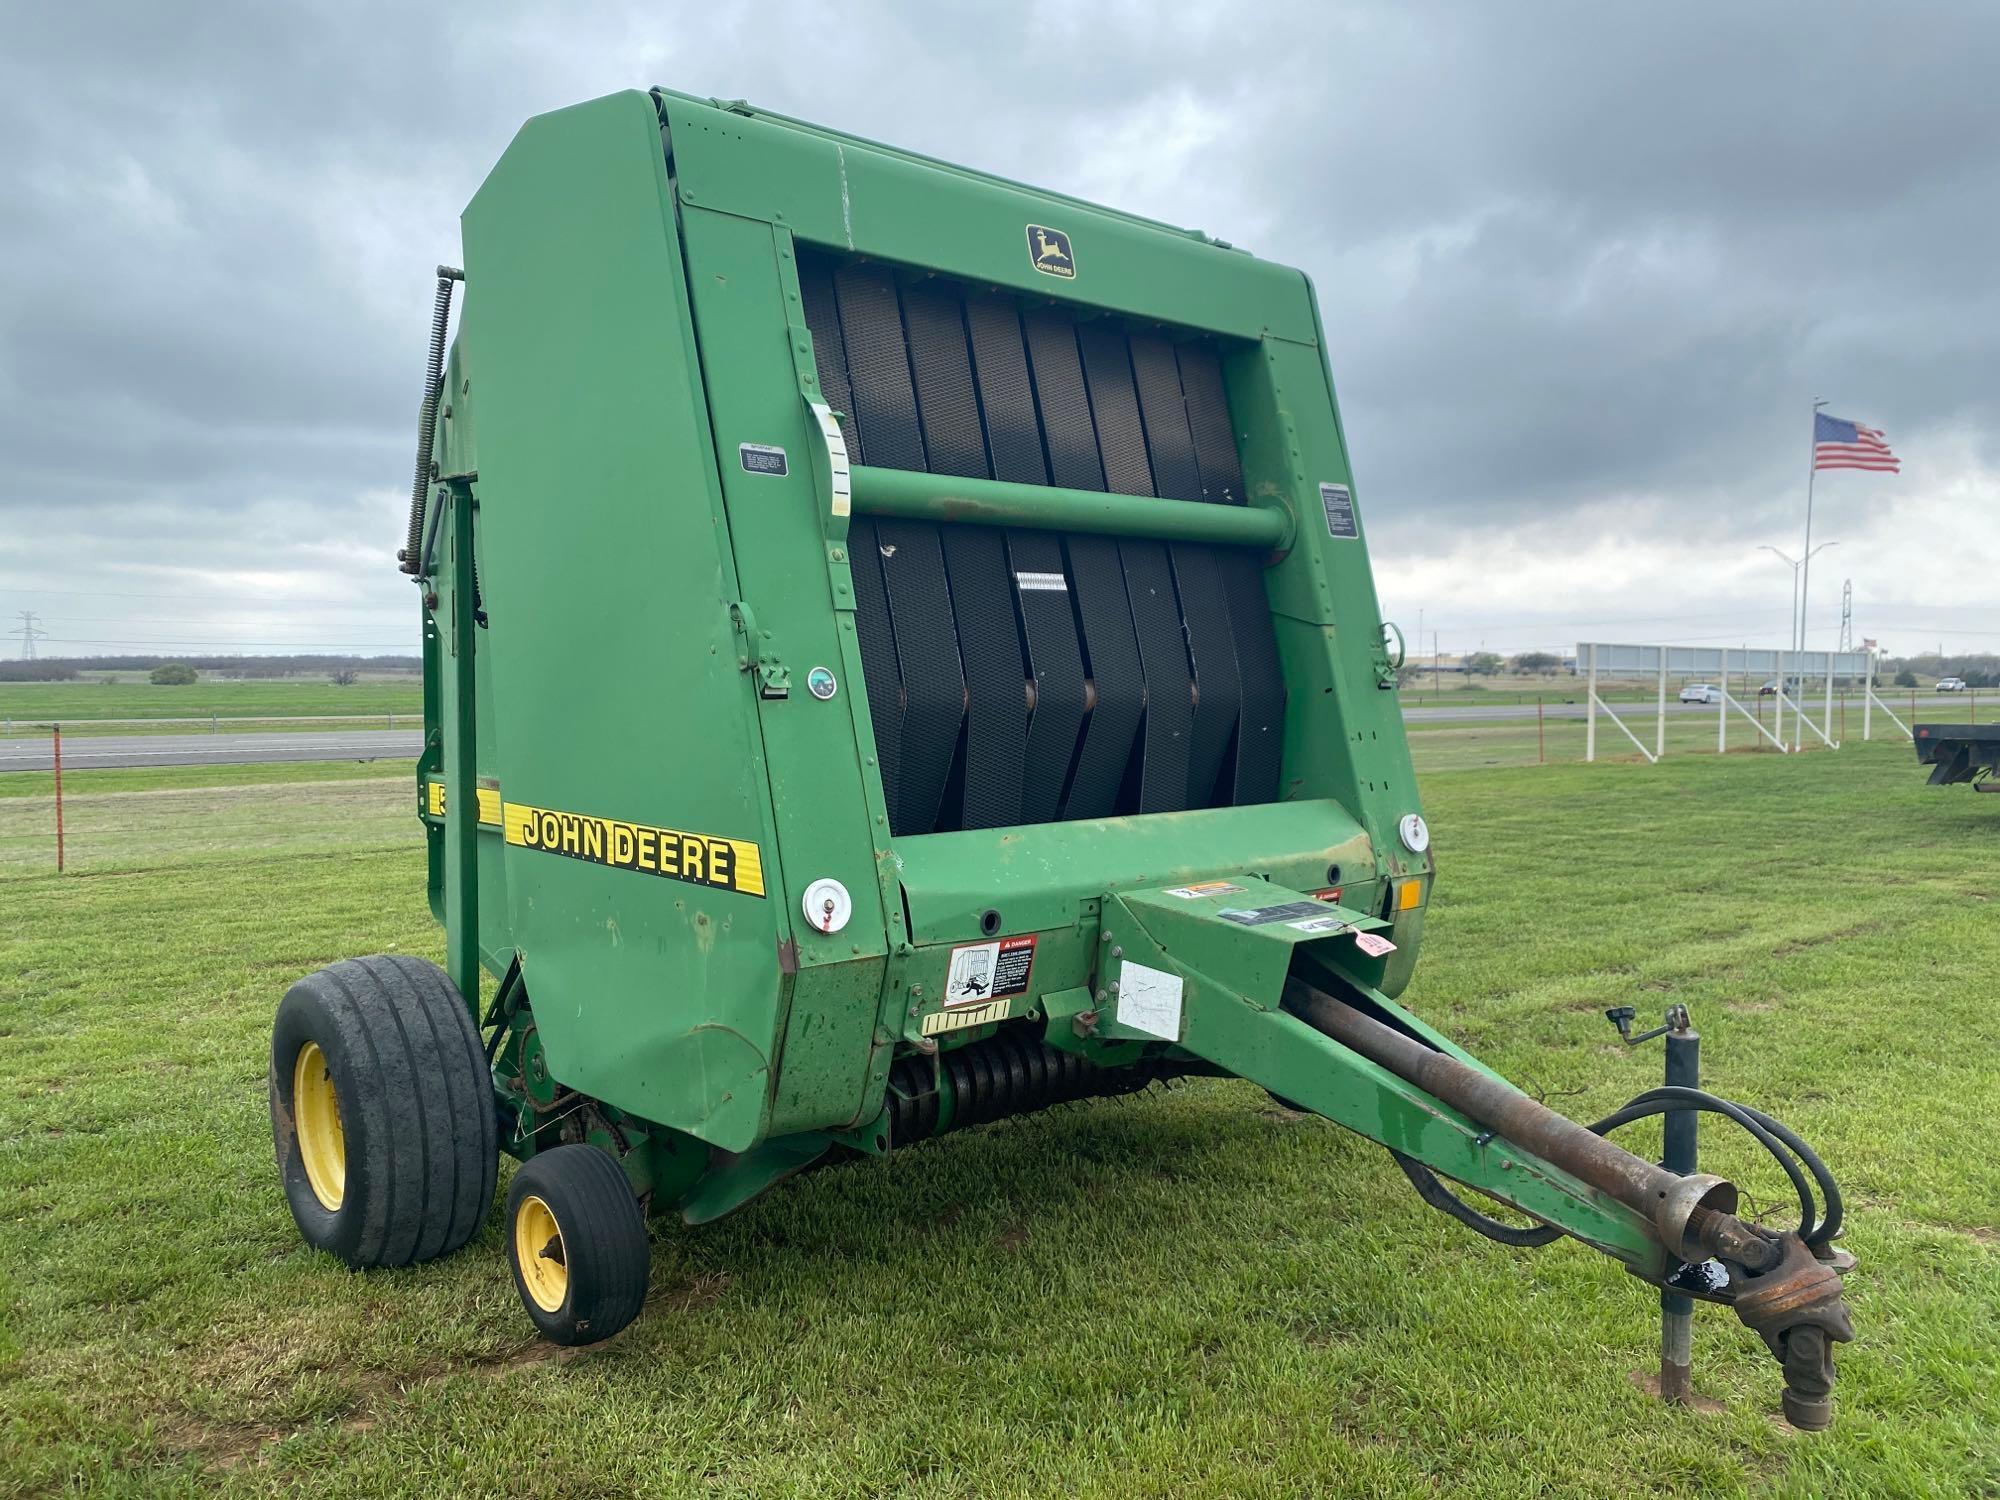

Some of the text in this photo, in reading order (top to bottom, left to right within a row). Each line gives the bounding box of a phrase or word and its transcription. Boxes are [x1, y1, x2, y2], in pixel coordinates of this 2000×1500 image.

[1036, 261, 1072, 275] JOHN DEERE
[523, 810, 735, 888] JOHN DEERE
[1011, 939, 1032, 948] DANGER
